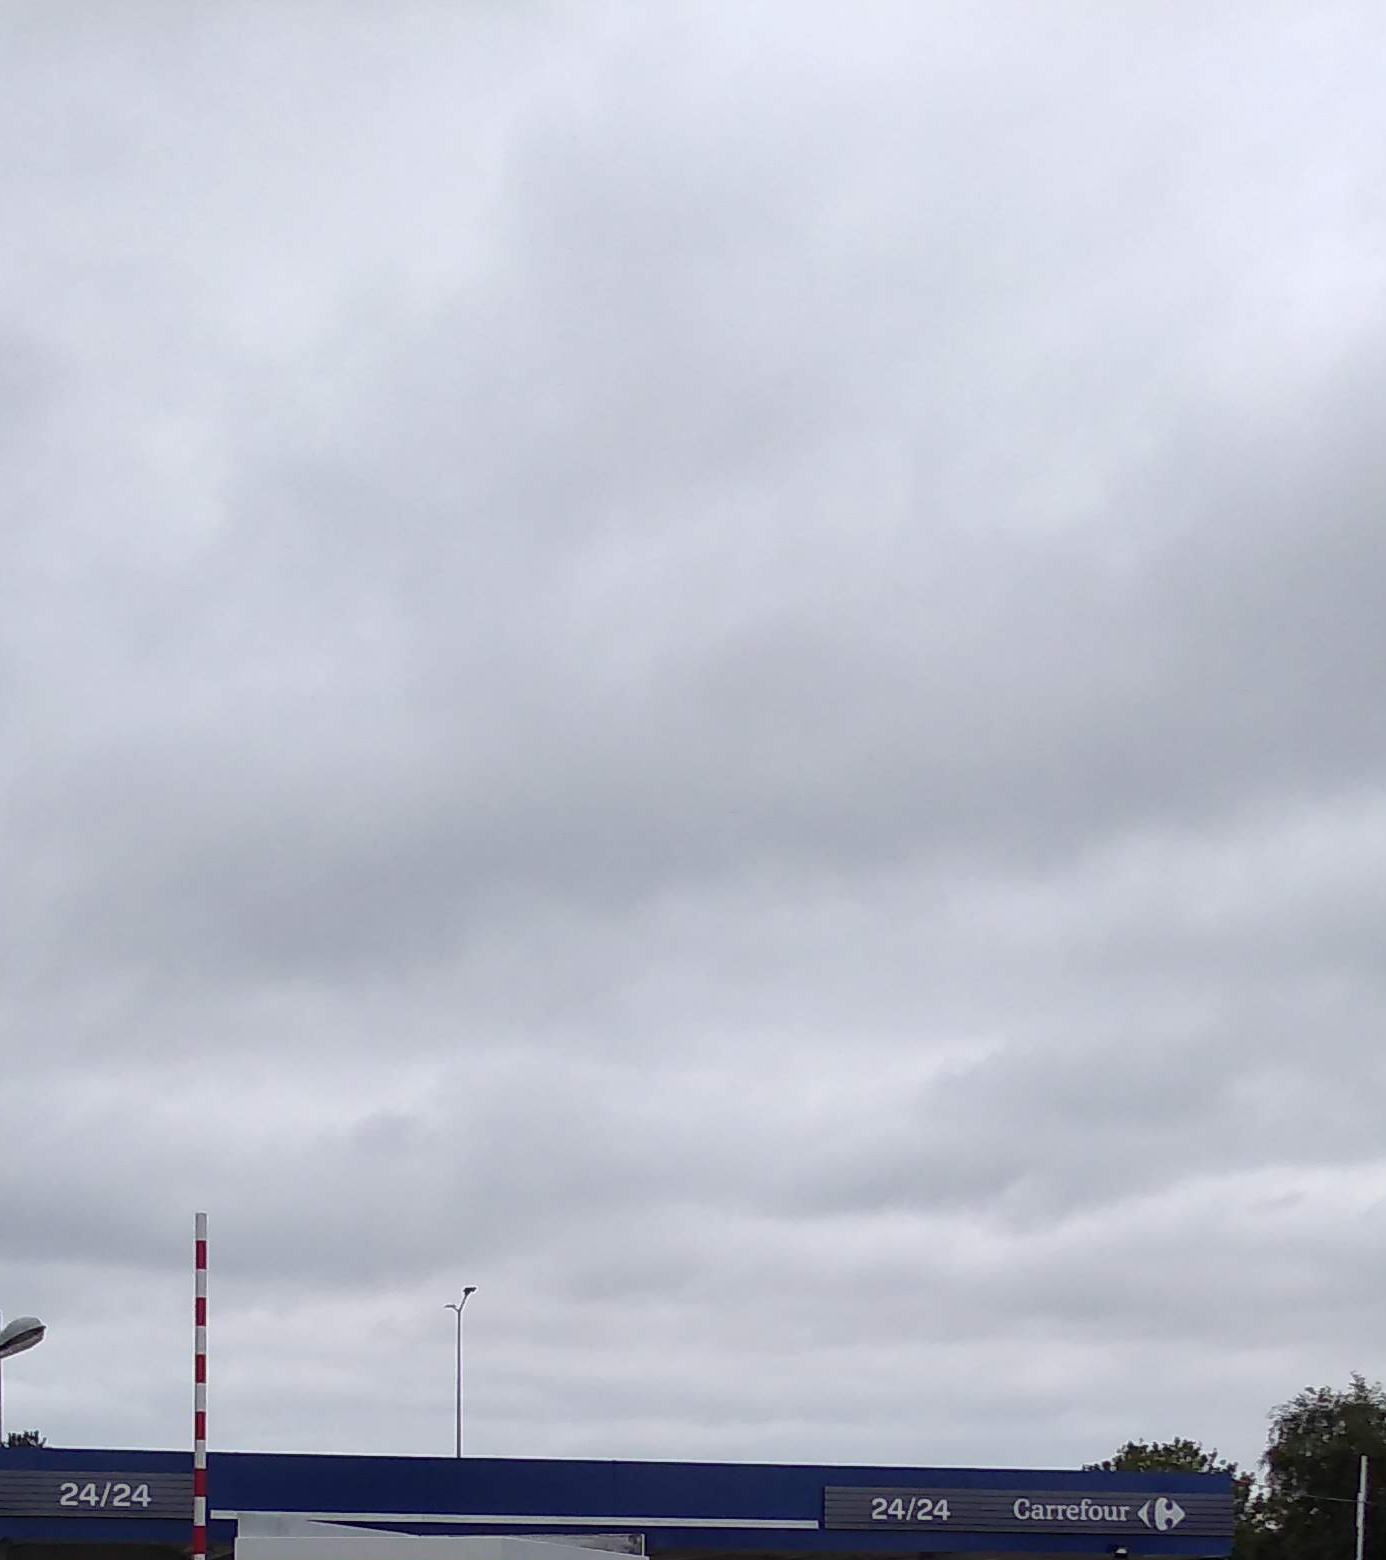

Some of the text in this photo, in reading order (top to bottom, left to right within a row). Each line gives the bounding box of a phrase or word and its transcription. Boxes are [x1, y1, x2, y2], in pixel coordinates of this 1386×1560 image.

[59, 1482, 152, 1508] 24/24
[871, 1497, 951, 1521] 24/24
[1013, 1498, 1130, 1521] Carrefour
